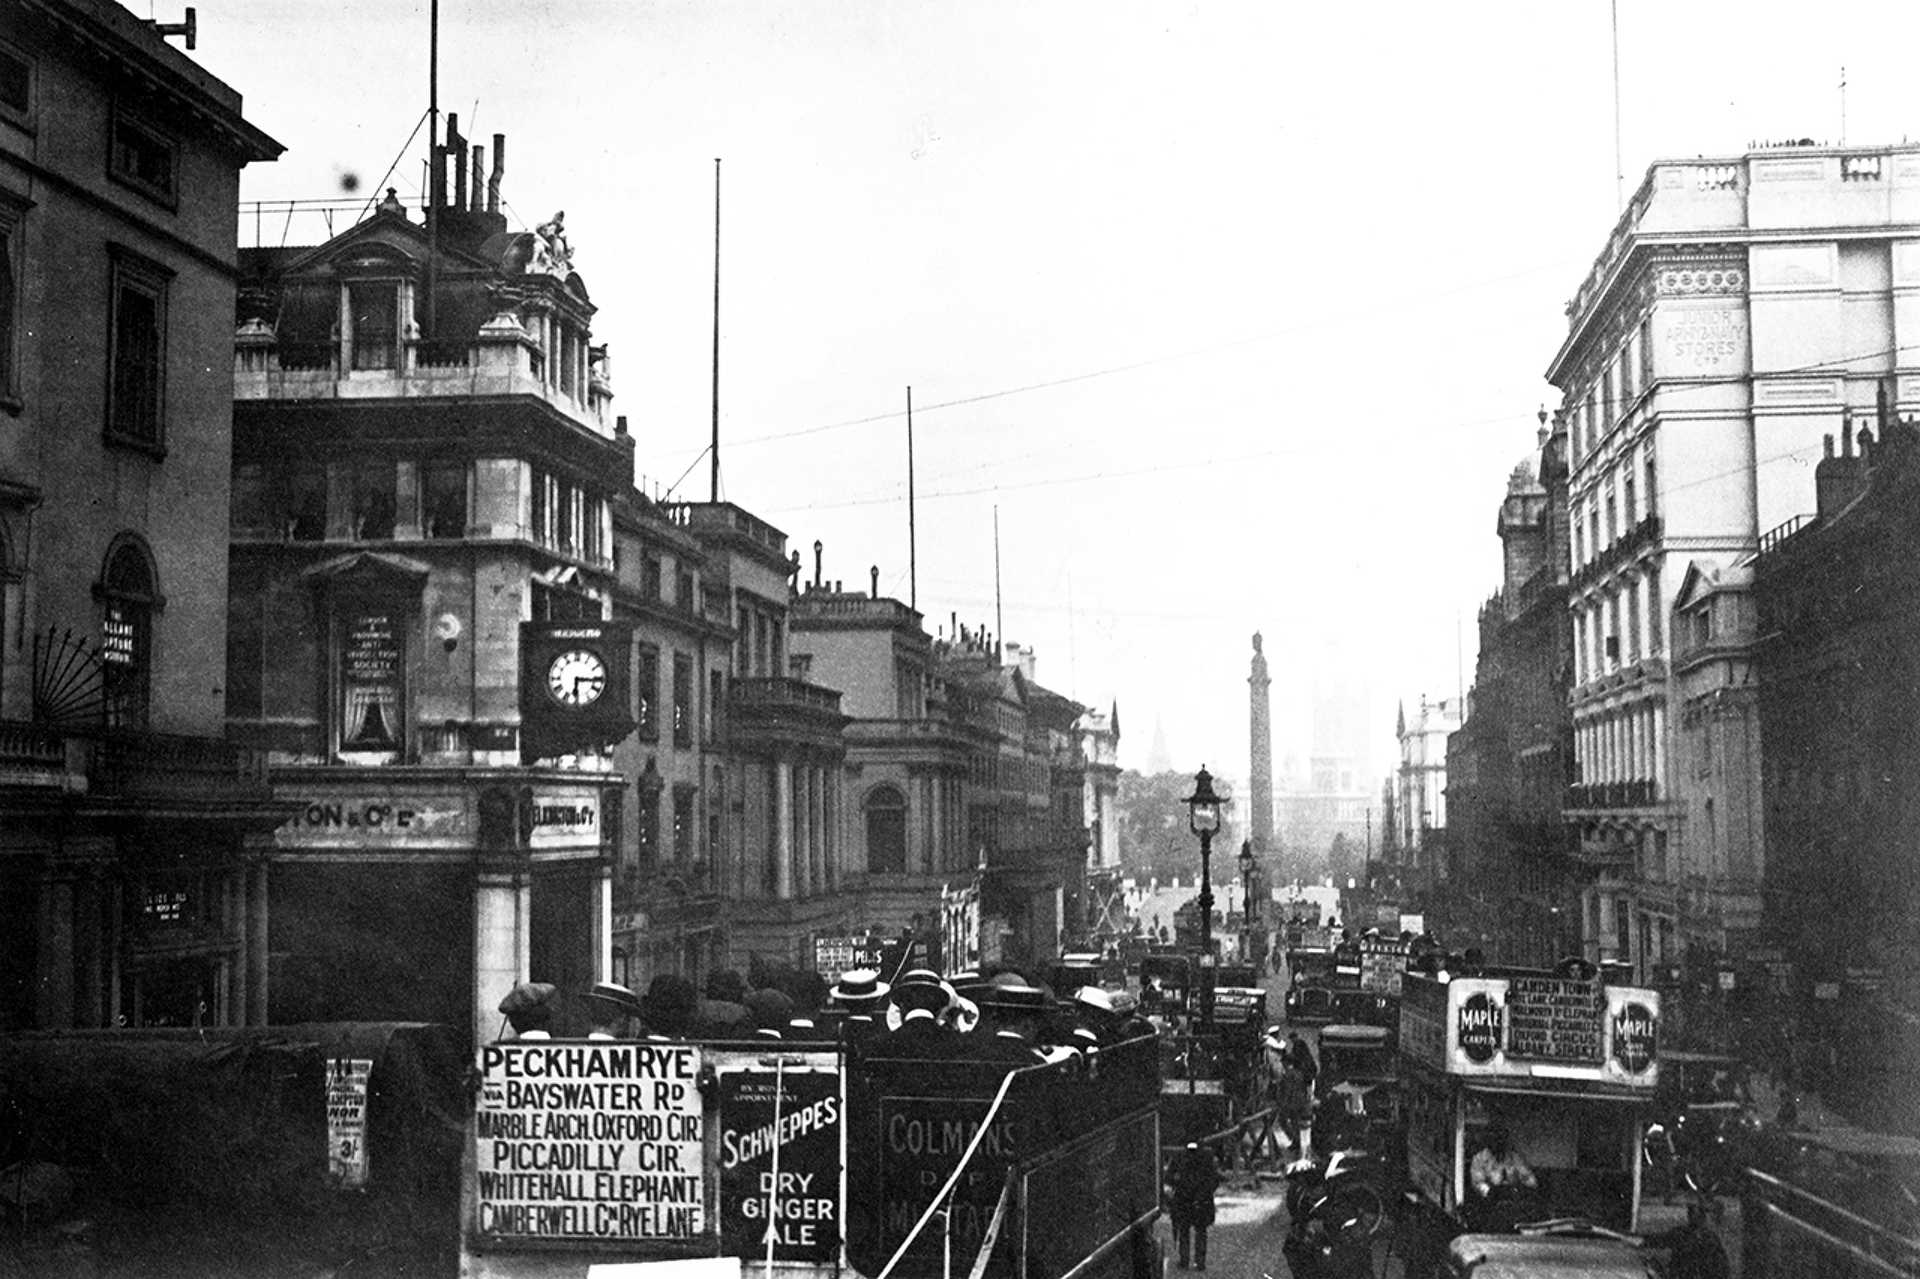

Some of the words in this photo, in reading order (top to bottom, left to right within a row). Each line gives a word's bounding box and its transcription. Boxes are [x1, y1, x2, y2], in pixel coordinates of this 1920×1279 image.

[1675, 341, 1736, 357] STORES
[1461, 1009, 1500, 1031] MAPLE
[1616, 1019, 1653, 1041] MAPLE
[482, 1046, 632, 1079] PECKHAM
[635, 1046, 694, 1079] RYE
[483, 1090, 505, 1102] VIA
[506, 1080, 643, 1111] BAYSWATER
[477, 1112, 543, 1140] MARBLE
[593, 1112, 662, 1141] OXFORD
[722, 1095, 838, 1169] SCHWEPPES
[494, 1140, 625, 1172] PICCADILLY
[759, 1172, 815, 1194] DRY
[480, 1202, 595, 1236] CAMBERWELL
[619, 1203, 653, 1237] RYE
[654, 1204, 701, 1237] LANE
[741, 1197, 834, 1221] GINGER
[761, 1223, 817, 1246] ALE
